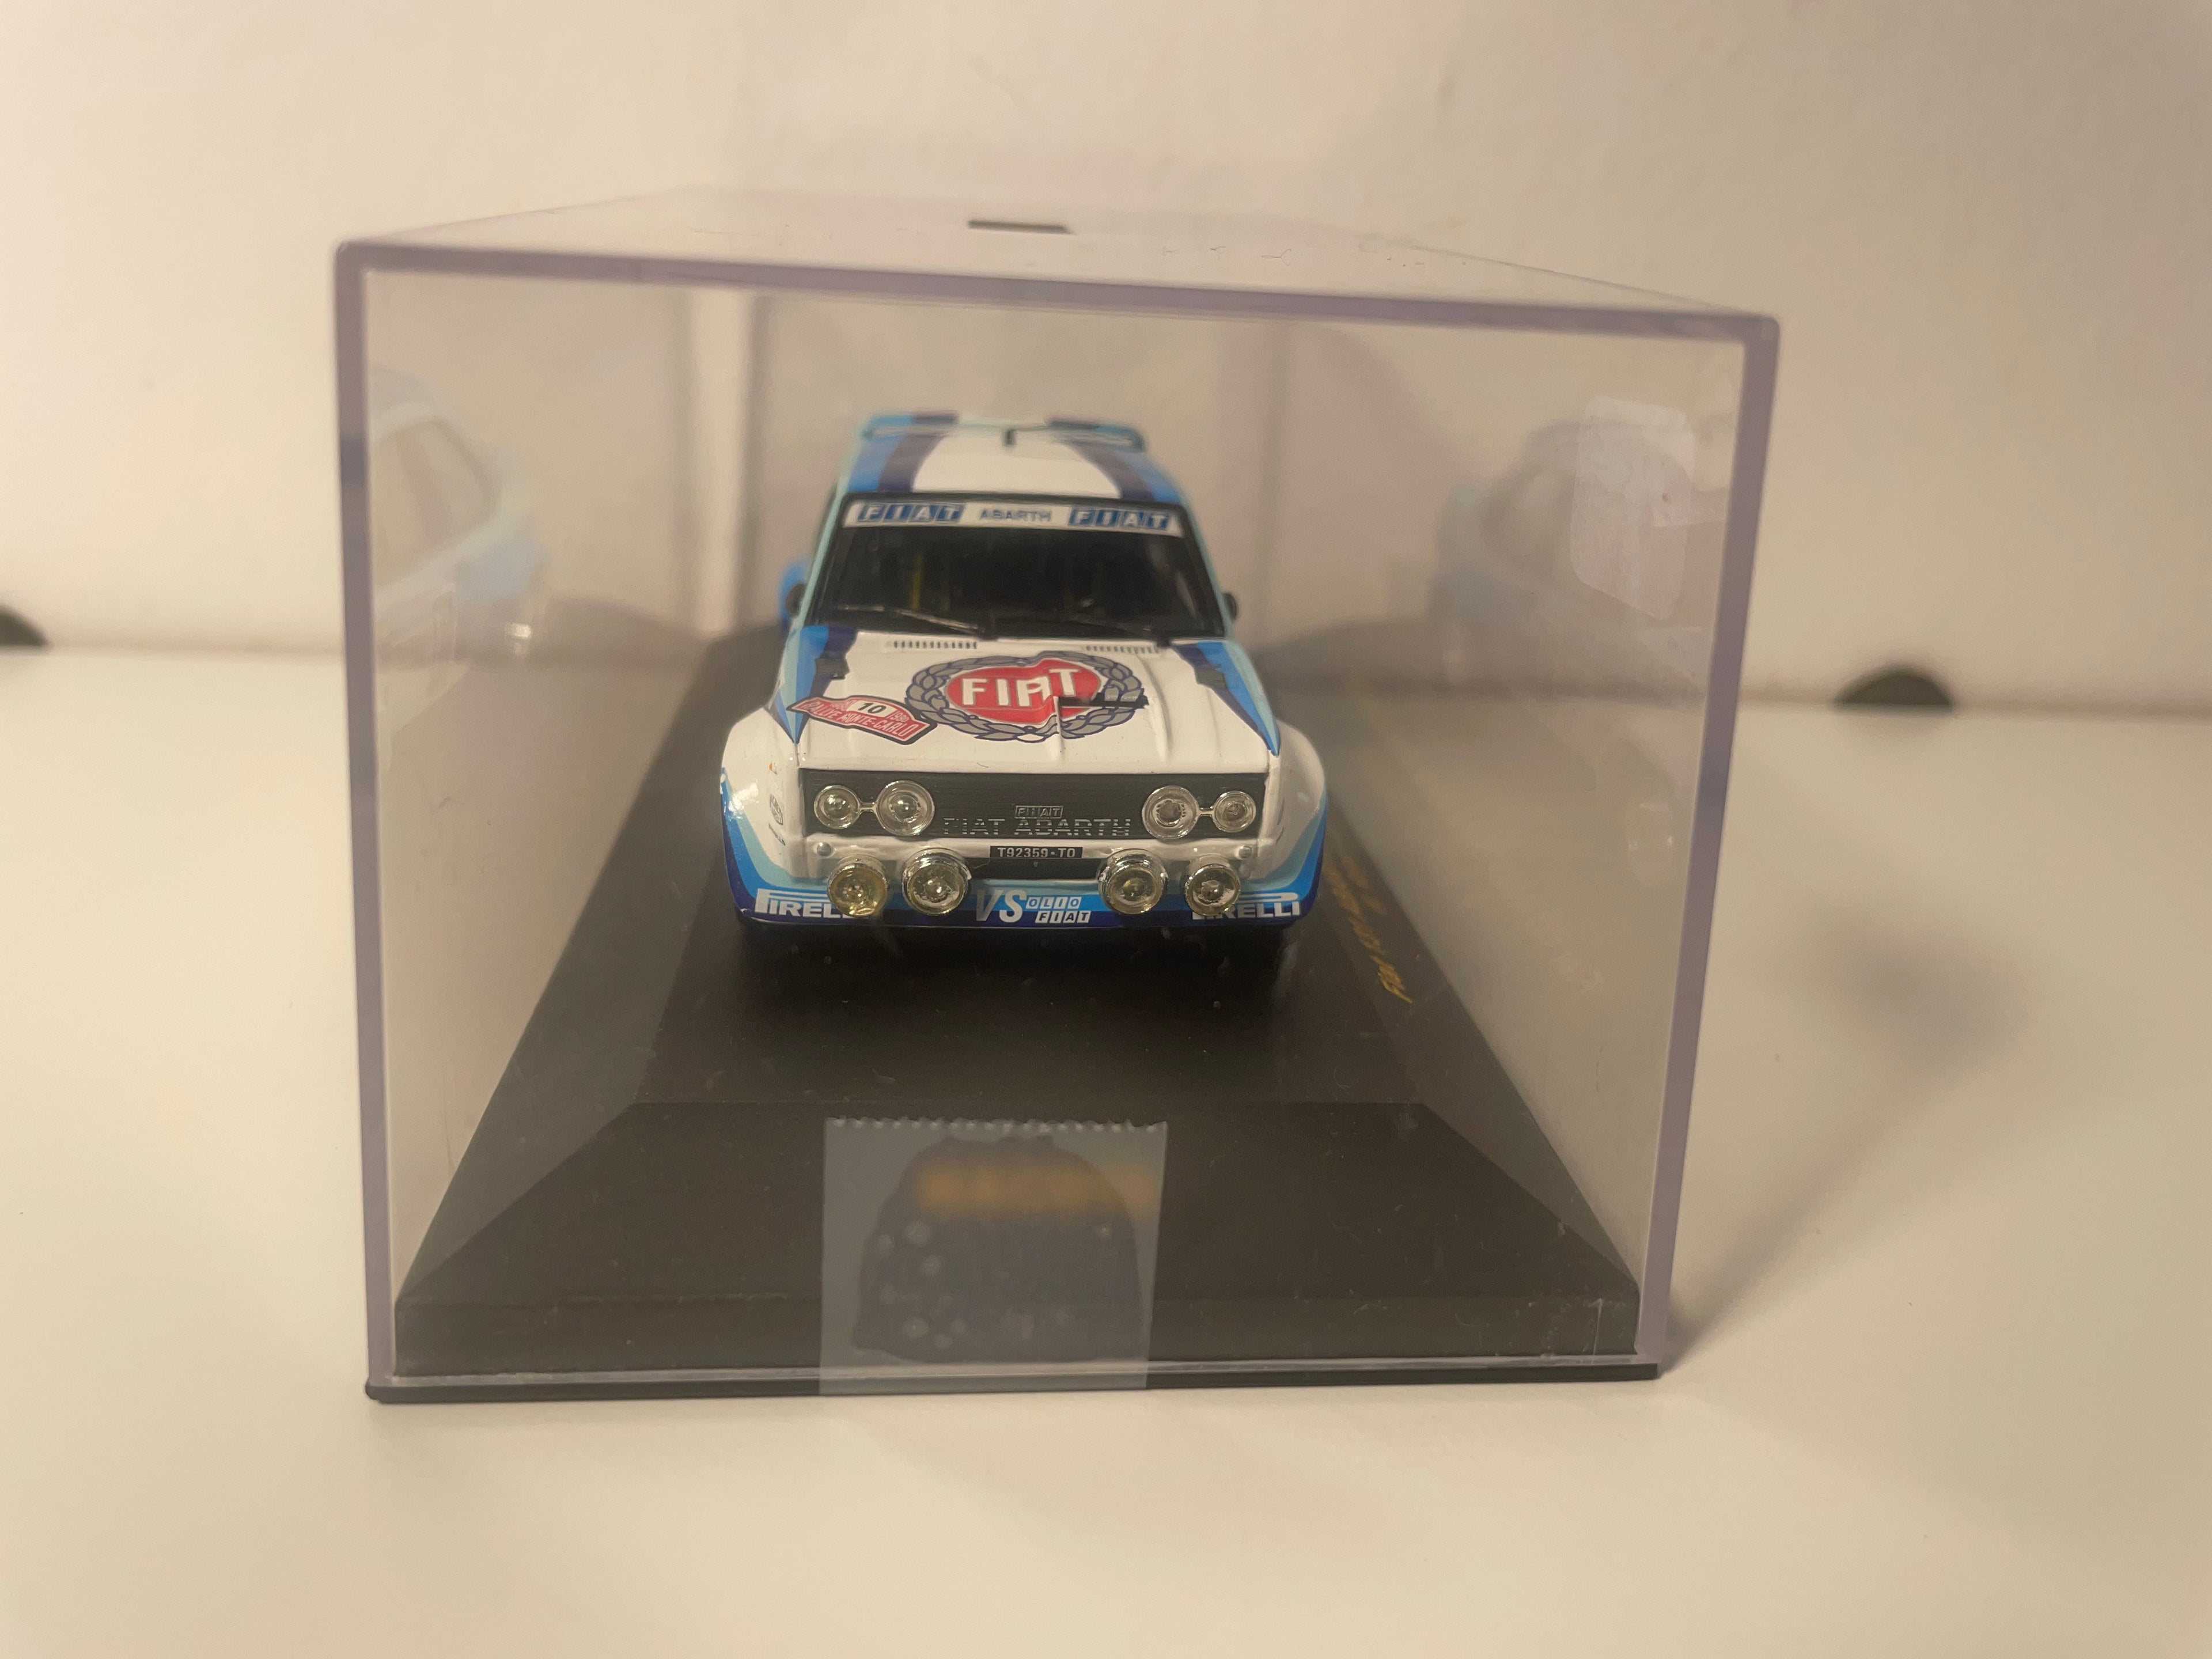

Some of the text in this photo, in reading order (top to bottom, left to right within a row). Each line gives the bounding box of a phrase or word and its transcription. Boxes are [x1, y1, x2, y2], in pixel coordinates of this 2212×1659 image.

[858, 502, 1171, 530] FIAT ABARTH FIAT
[961, 668, 1080, 707] FIAT
[858, 702, 887, 714] 10
[1018, 808, 1061, 817] FIAT
[944, 817, 1131, 836] FIAT ABARTH
[755, 888, 855, 919] PIREL
[976, 889, 1027, 923] VS
[1028, 897, 1079, 908] OLIO
[1037, 911, 1090, 923] FIAT
